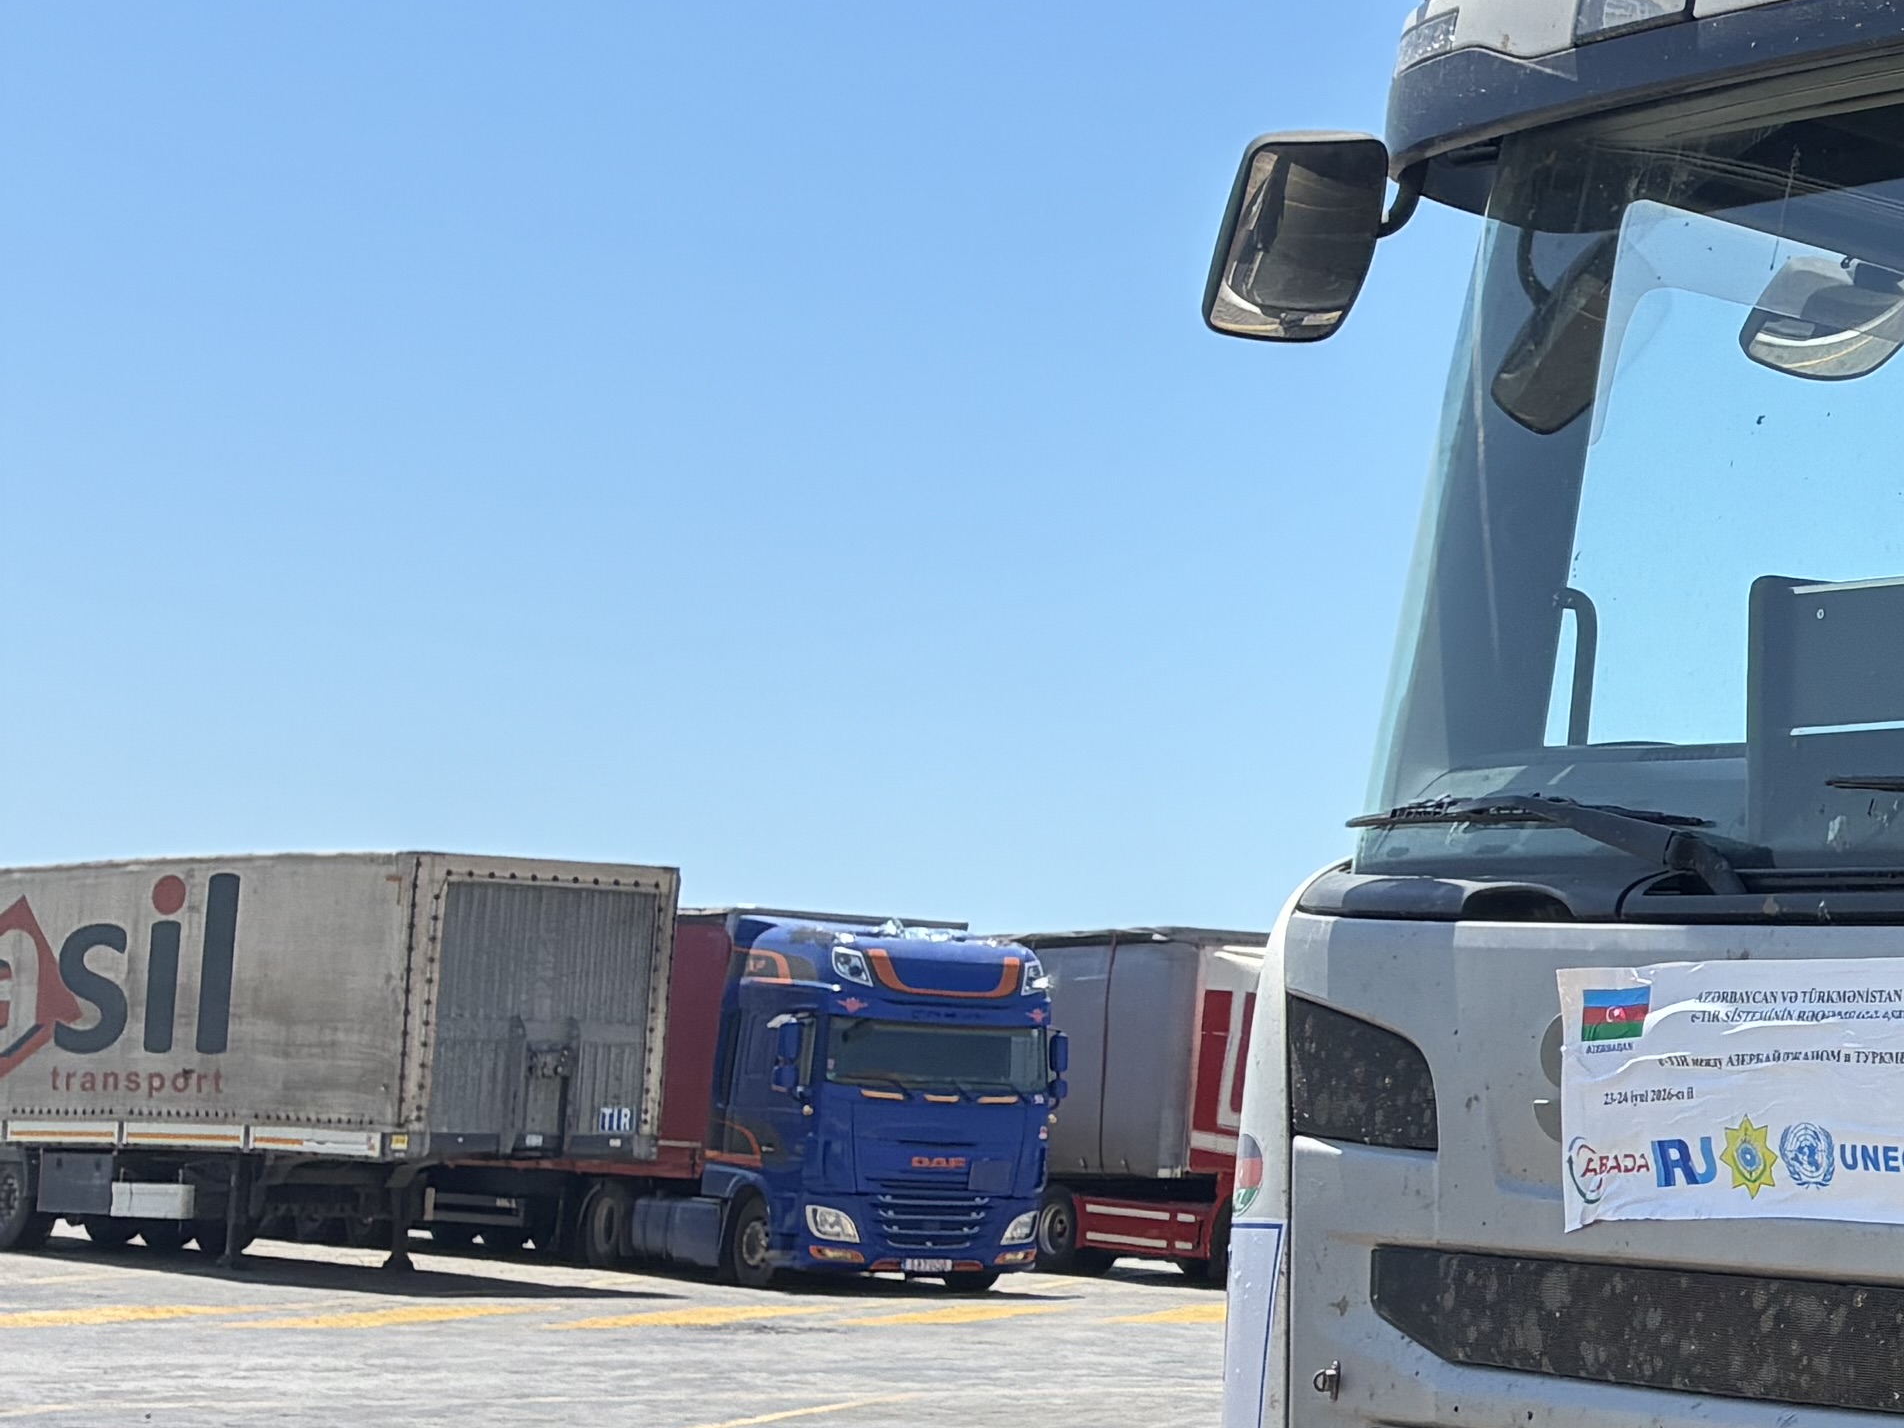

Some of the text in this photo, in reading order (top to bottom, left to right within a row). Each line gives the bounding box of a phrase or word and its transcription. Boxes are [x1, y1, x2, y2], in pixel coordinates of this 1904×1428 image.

[50, 1065, 224, 1098] transport
[603, 1107, 632, 1131] TIR
[911, 1156, 967, 1169] DAF
[1651, 1136, 1718, 1188] IRU
